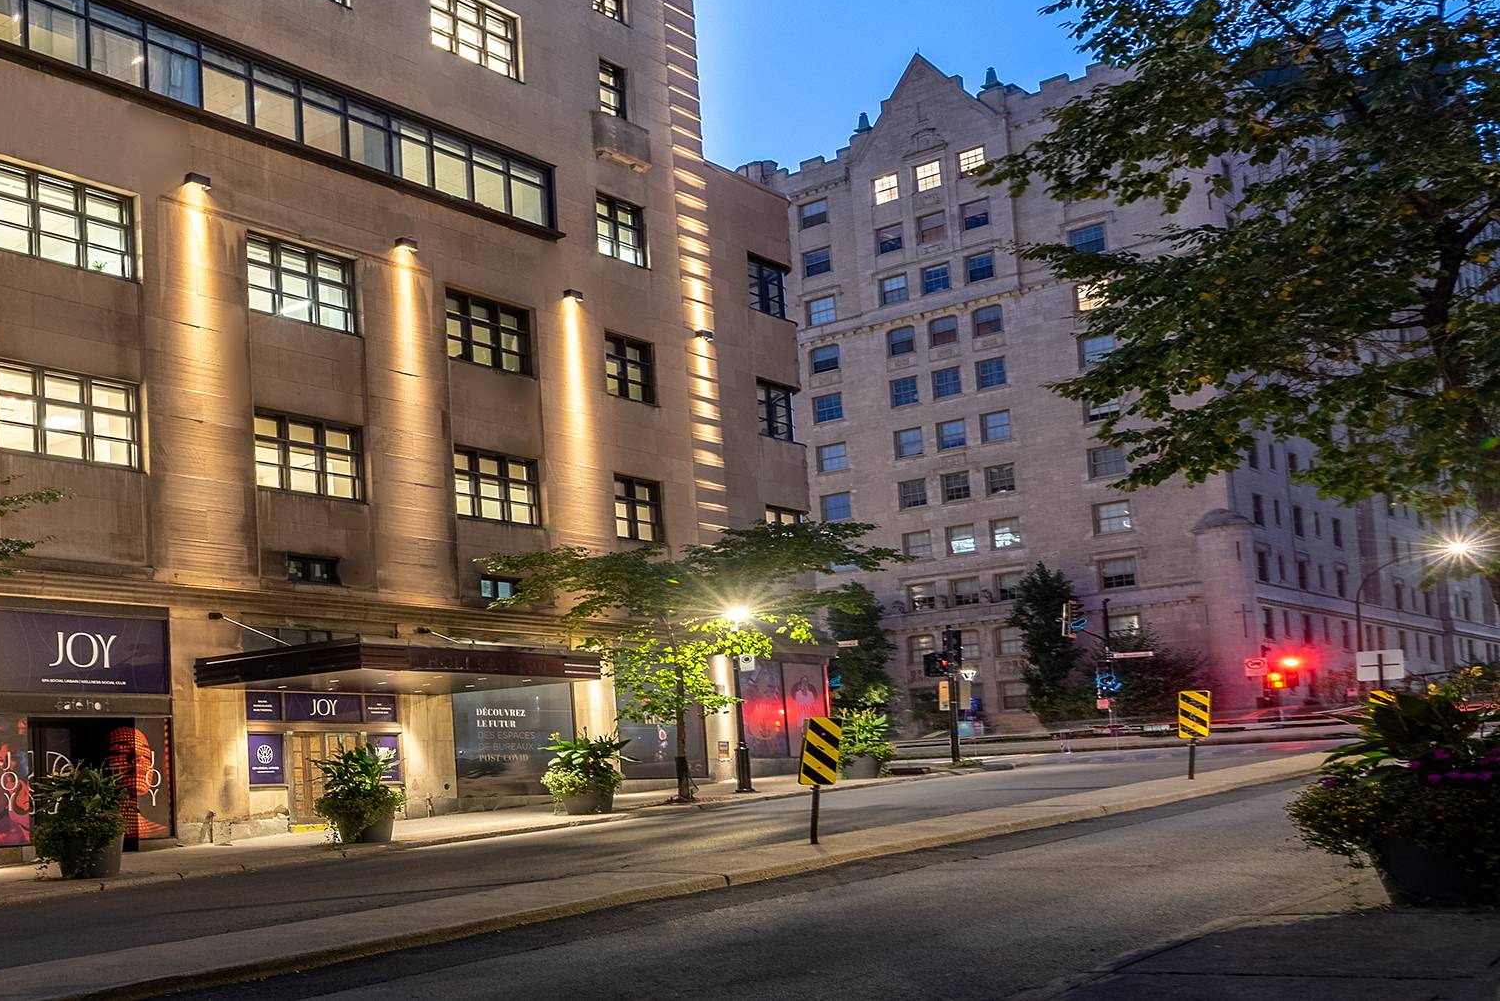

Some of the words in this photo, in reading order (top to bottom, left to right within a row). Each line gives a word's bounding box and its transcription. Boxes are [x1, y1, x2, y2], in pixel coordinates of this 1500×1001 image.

[48, 631, 117, 669] JOY
[309, 698, 338, 716] JOY
[475, 706, 526, 717] DÉCOUVREZ
[476, 719, 488, 728] LE
[488, 719, 517, 728] FUTUR
[477, 731, 495, 739] DES
[497, 731, 536, 739] ESPACES
[478, 742, 491, 750] DE
[493, 742, 534, 750] BUREAUX
